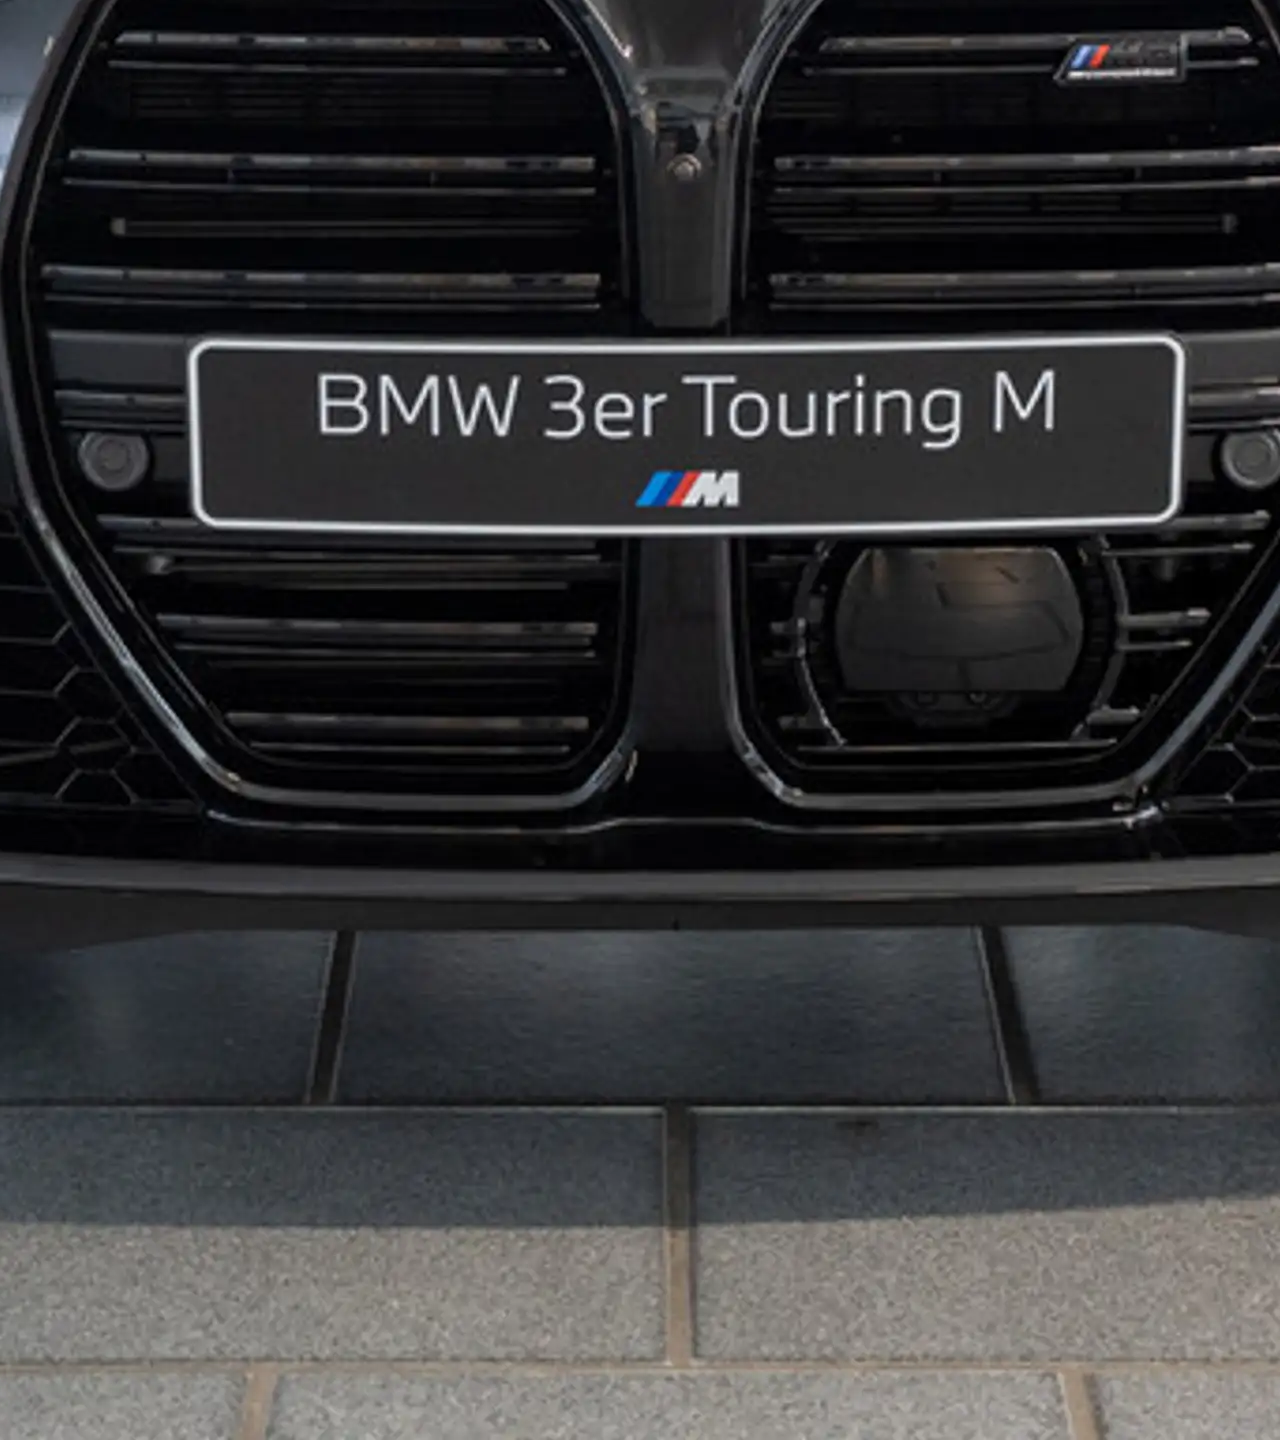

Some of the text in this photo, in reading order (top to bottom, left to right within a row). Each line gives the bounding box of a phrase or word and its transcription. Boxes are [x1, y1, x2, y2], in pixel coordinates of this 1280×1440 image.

[318, 369, 1055, 450] BMW 3er Touring M
[681, 469, 740, 507] M
